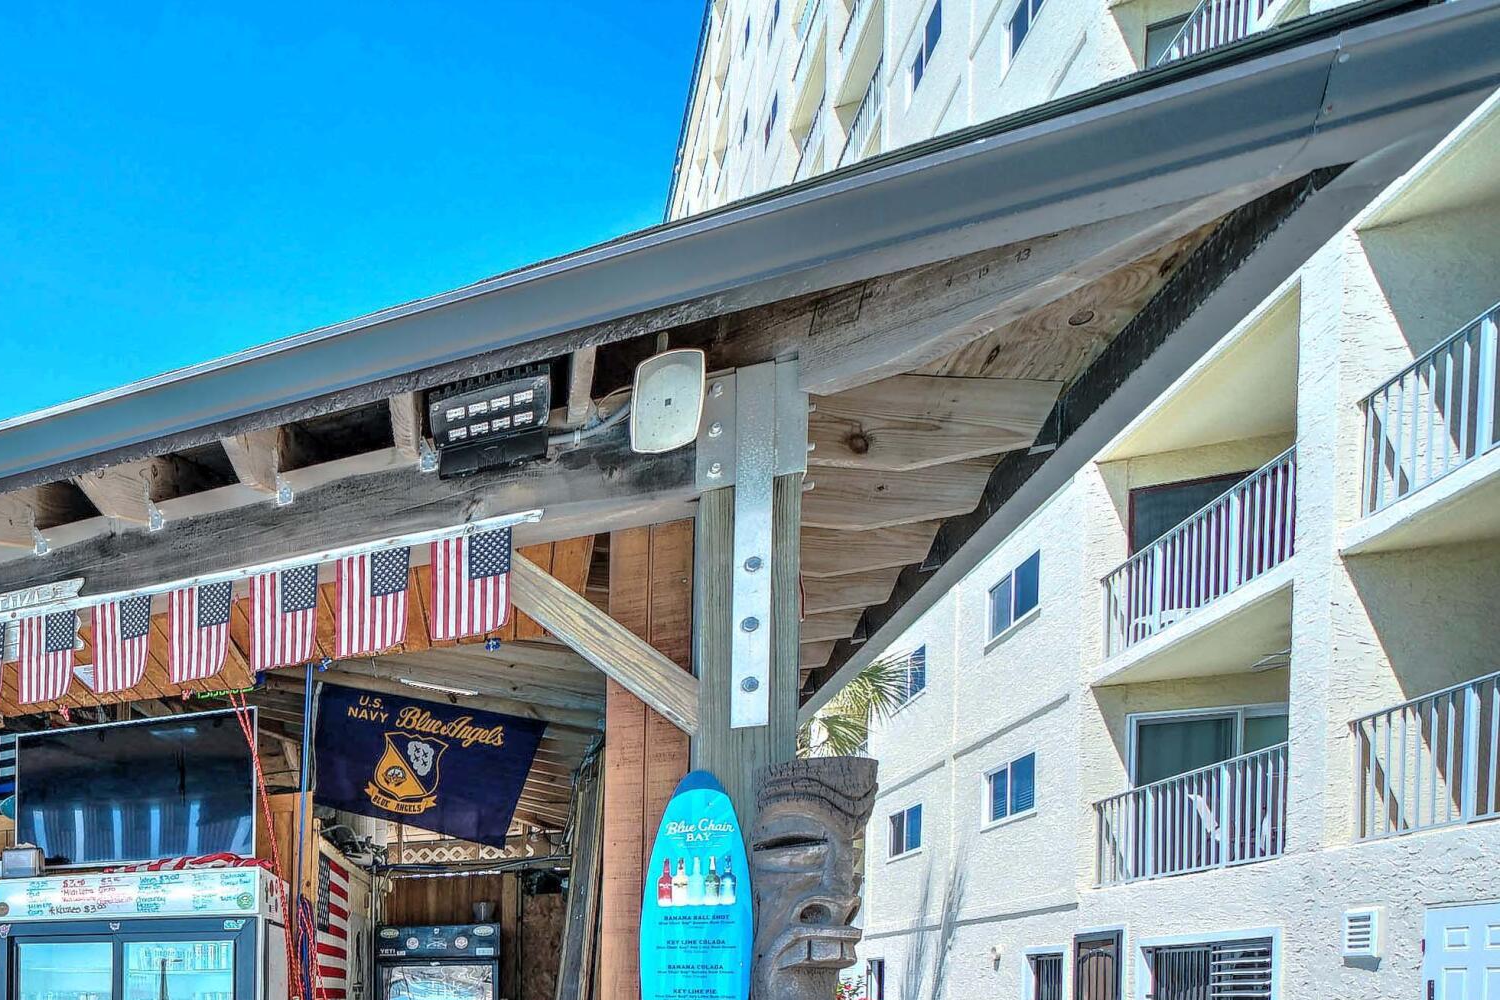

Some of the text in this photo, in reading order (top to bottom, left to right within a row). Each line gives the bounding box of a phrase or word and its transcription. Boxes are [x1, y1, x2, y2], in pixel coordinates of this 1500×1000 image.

[359, 696, 384, 710] U.S.
[347, 707, 389, 723] NAVY
[396, 706, 504, 748] Blue Angels
[372, 794, 422, 812] BLUE ANGELS
[665, 818, 735, 835] Blue Chair
[686, 833, 712, 841] BAY
